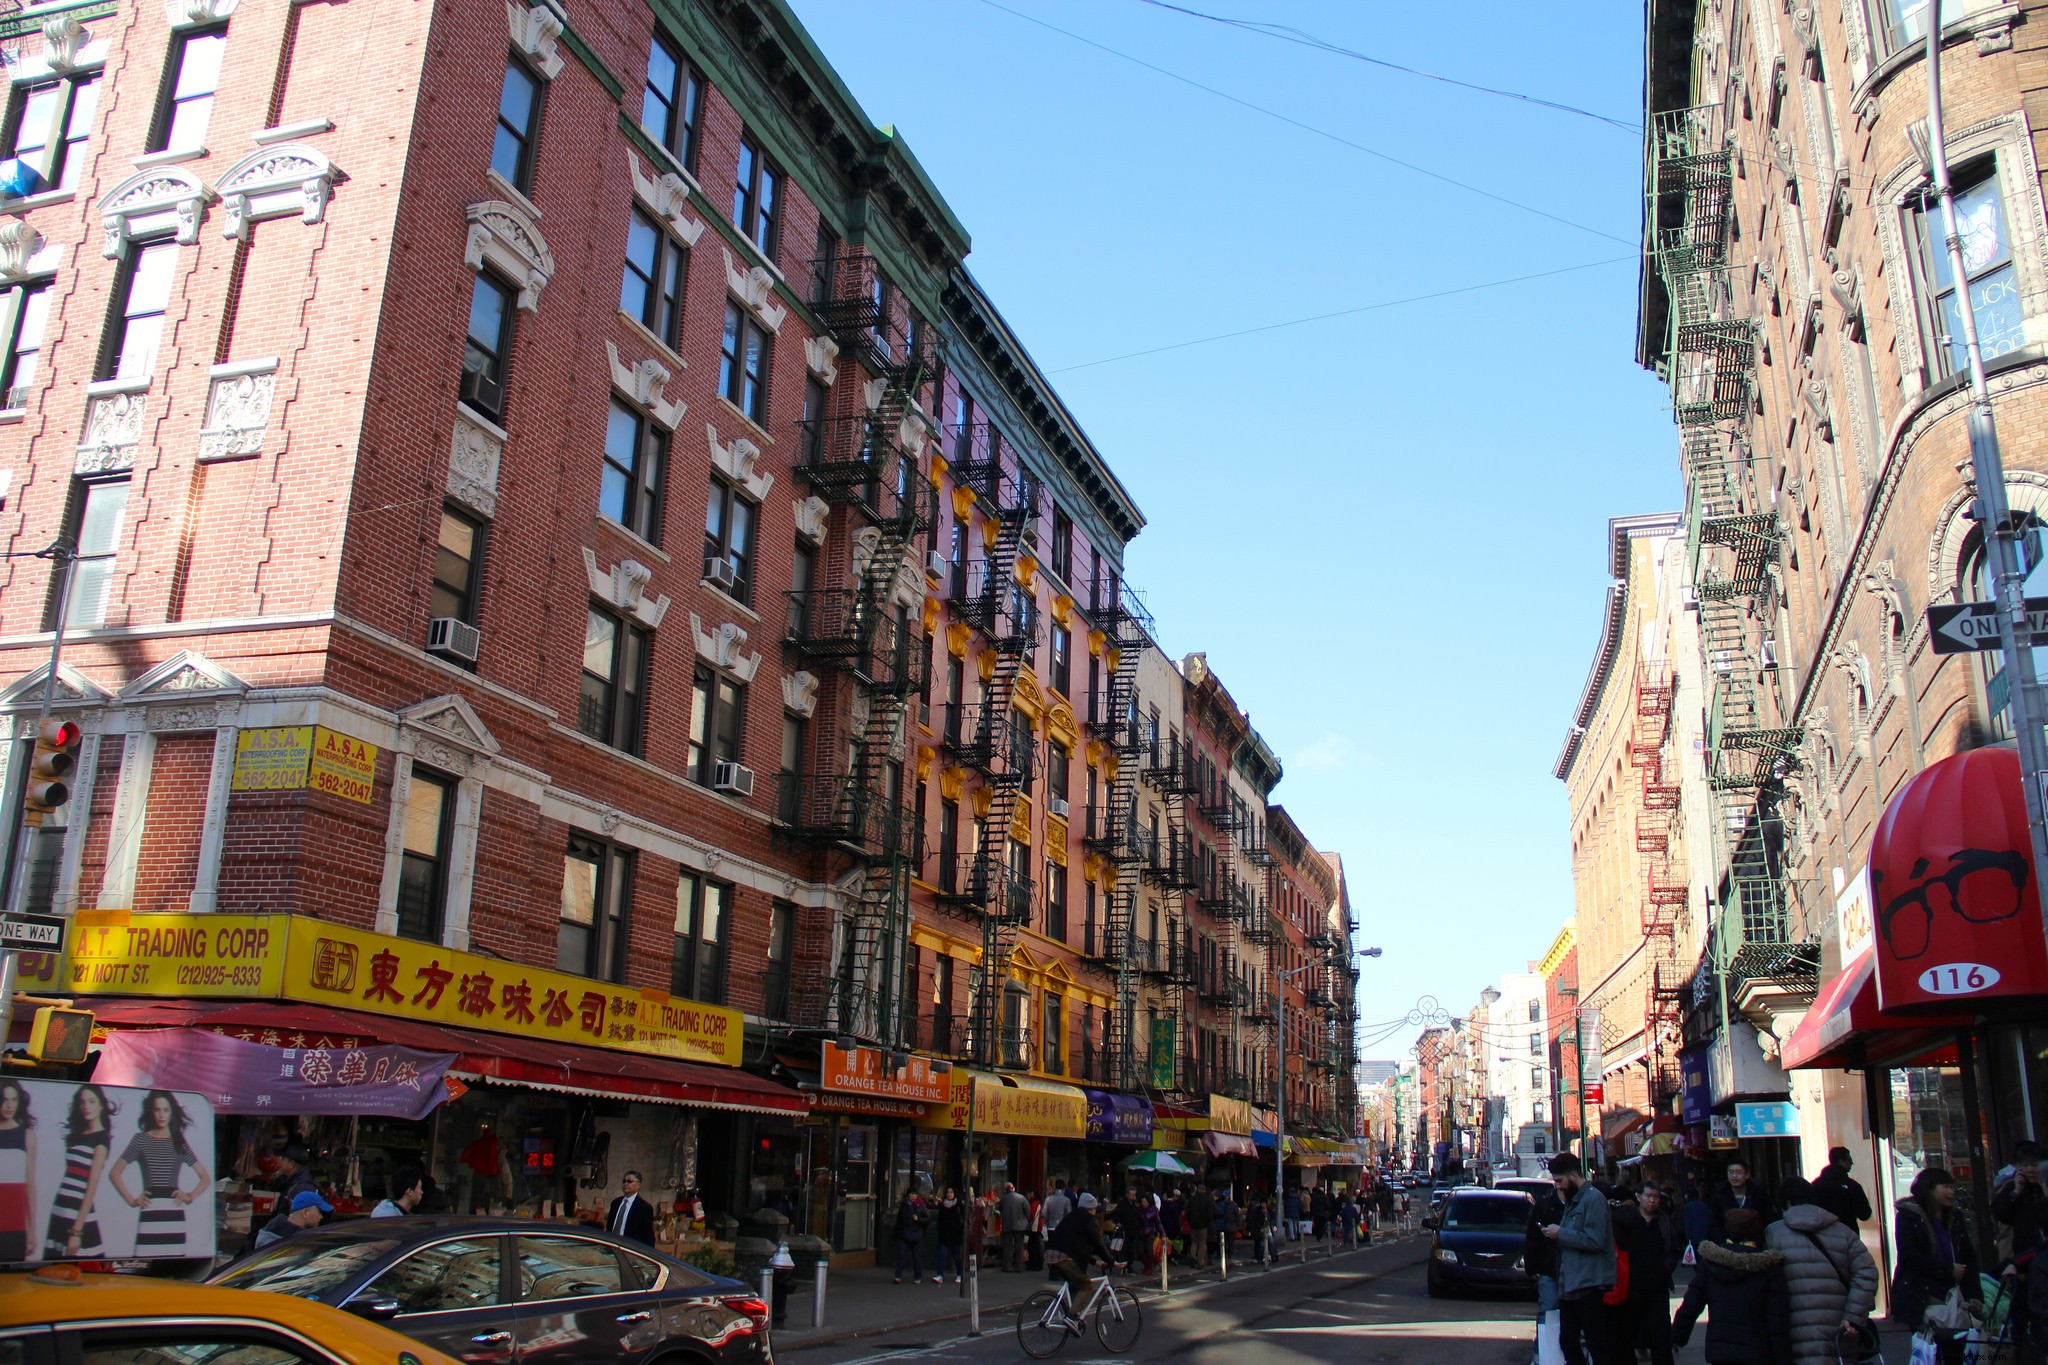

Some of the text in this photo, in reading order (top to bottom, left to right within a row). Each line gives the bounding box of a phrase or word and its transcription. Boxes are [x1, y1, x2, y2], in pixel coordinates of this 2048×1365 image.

[1960, 616, 2001, 637] ON
[240, 750, 288, 759] WATERPROOFING
[316, 748, 357, 769] WATERPROOFING
[242, 770, 305, 787] 562-2047
[318, 771, 371, 801] 562-2047
[29, 926, 54, 940] WAY
[127, 928, 207, 958] TRADING
[216, 928, 269, 958] CORP.
[73, 963, 261, 985] 121 MOTT ST. (212)925-8333
[1928, 966, 1985, 991] 116
[363, 948, 607, 1038] 東方海味公司
[661, 1006, 701, 1034] TRADING
[703, 1013, 728, 1038] CORP.
[639, 1030, 648, 1045] 121
[650, 1031, 668, 1049] MOTT
[835, 1073, 944, 1100] ORANGE TEA HOUSE INC.
[821, 1095, 856, 1109] ORANGE
[857, 1099, 872, 1110] TEA
[873, 1103, 898, 1114] HOUSE
[899, 1107, 914, 1115] INC.
